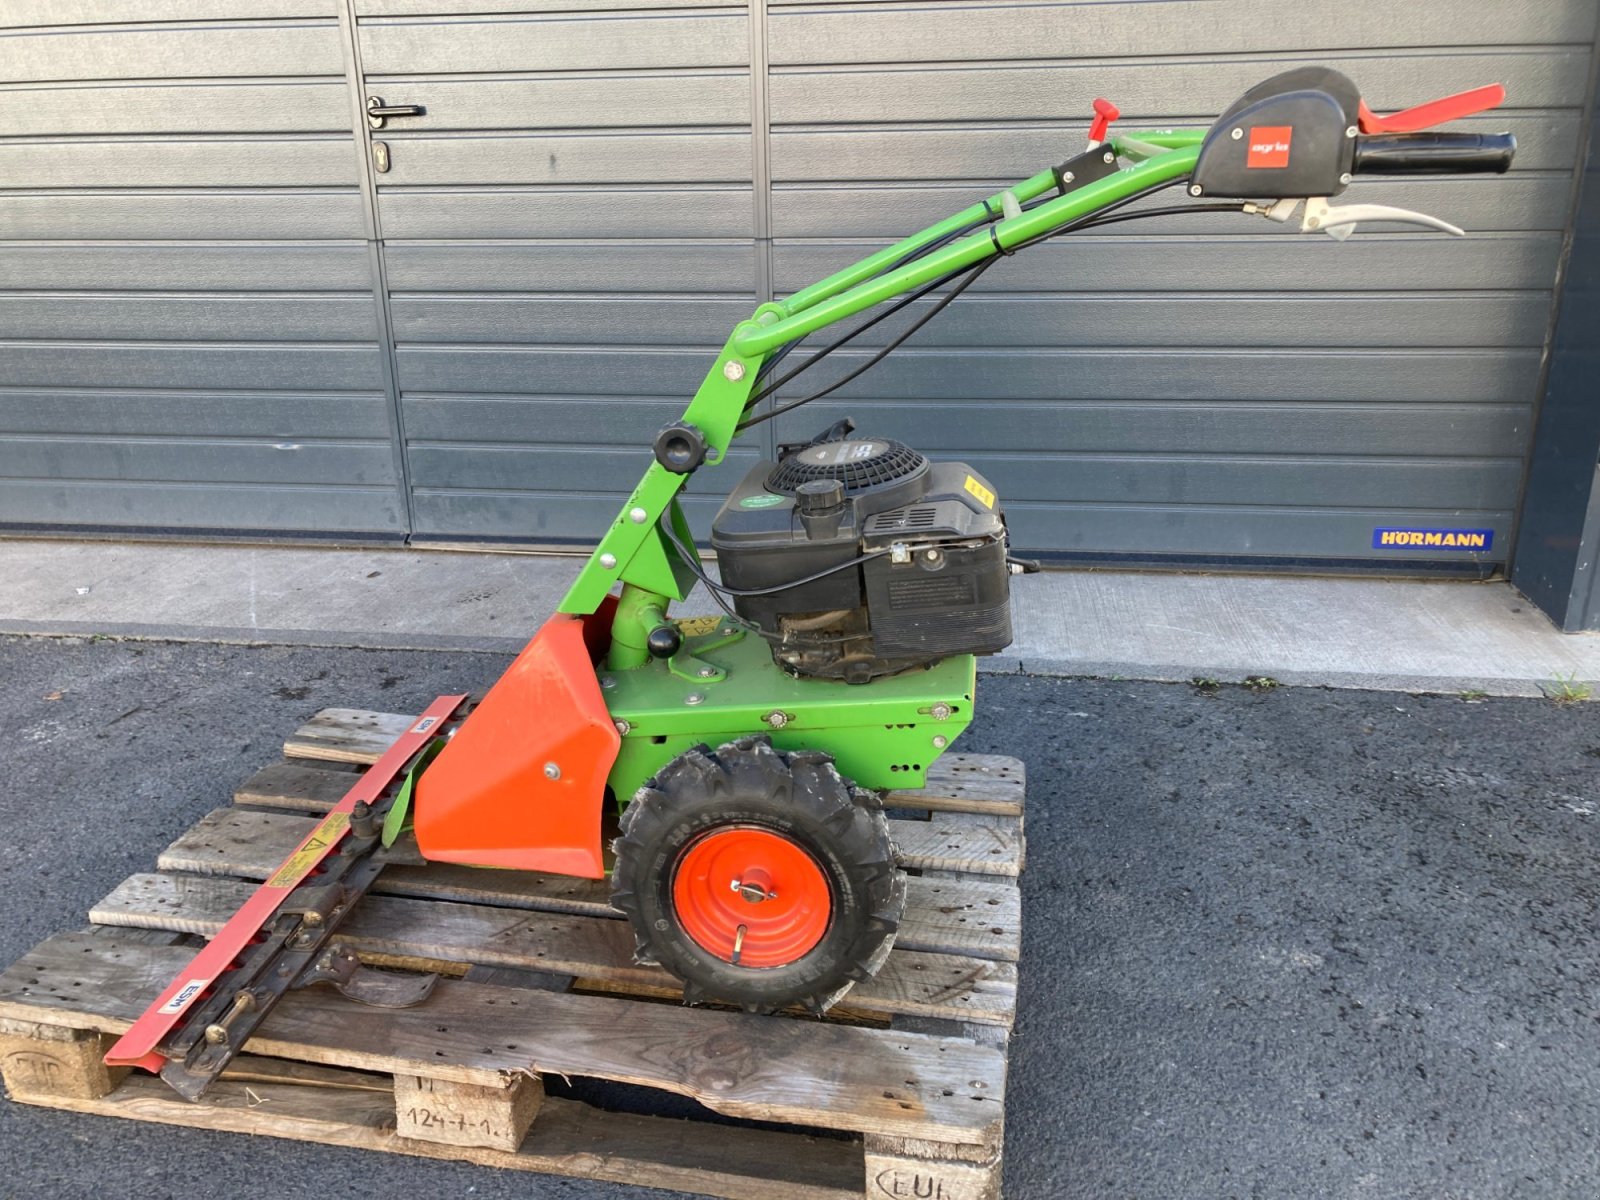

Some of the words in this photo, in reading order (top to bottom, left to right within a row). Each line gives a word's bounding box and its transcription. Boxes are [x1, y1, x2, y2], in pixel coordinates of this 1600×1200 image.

[1252, 141, 1289, 154] agria
[1381, 531, 1485, 547] HÖRMANN
[169, 985, 201, 1007] ESM
